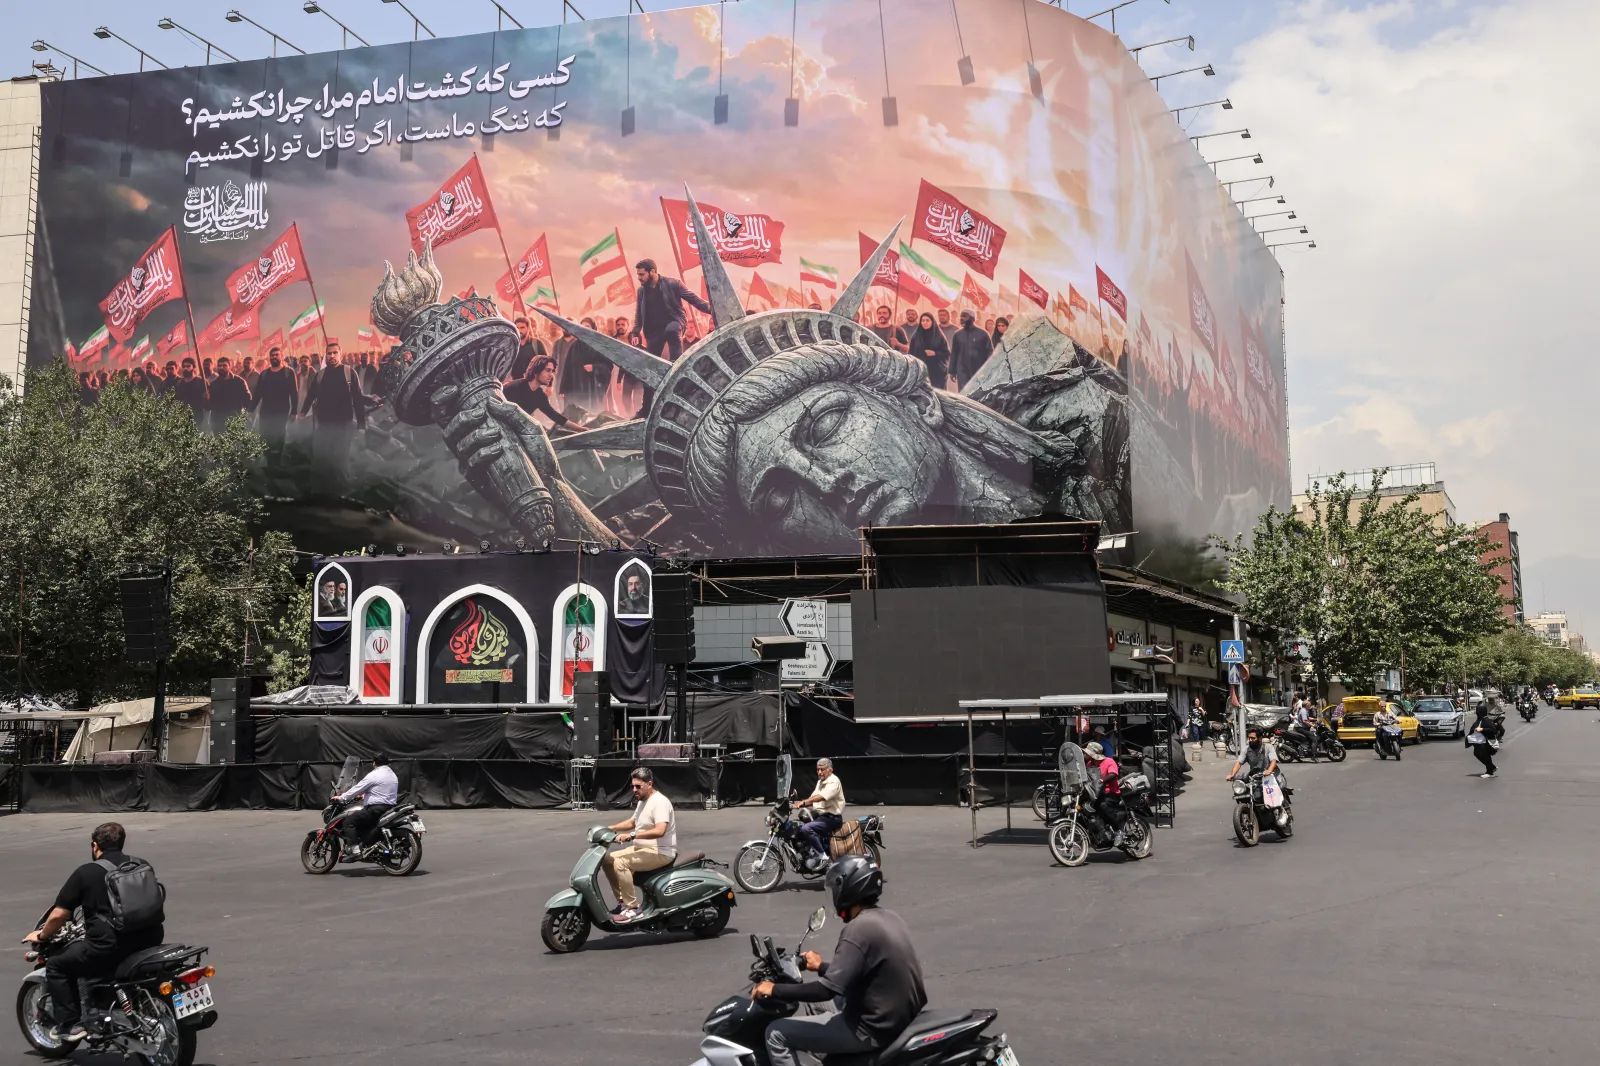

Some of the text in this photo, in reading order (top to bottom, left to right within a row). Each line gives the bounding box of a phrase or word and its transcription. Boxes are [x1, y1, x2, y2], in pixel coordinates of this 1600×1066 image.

[406, 66, 478, 100] کشت
[475, 62, 511, 92] که
[509, 55, 576, 98] کسی
[276, 88, 313, 124] چرا
[355, 74, 404, 119] امام
[480, 106, 529, 134] ننگ
[535, 101, 568, 127] که
[263, 133, 276, 163] را
[279, 134, 303, 161] تو
[306, 125, 356, 158] قاتل
[357, 119, 393, 153] اگر
[185, 136, 259, 175] نکشیم
